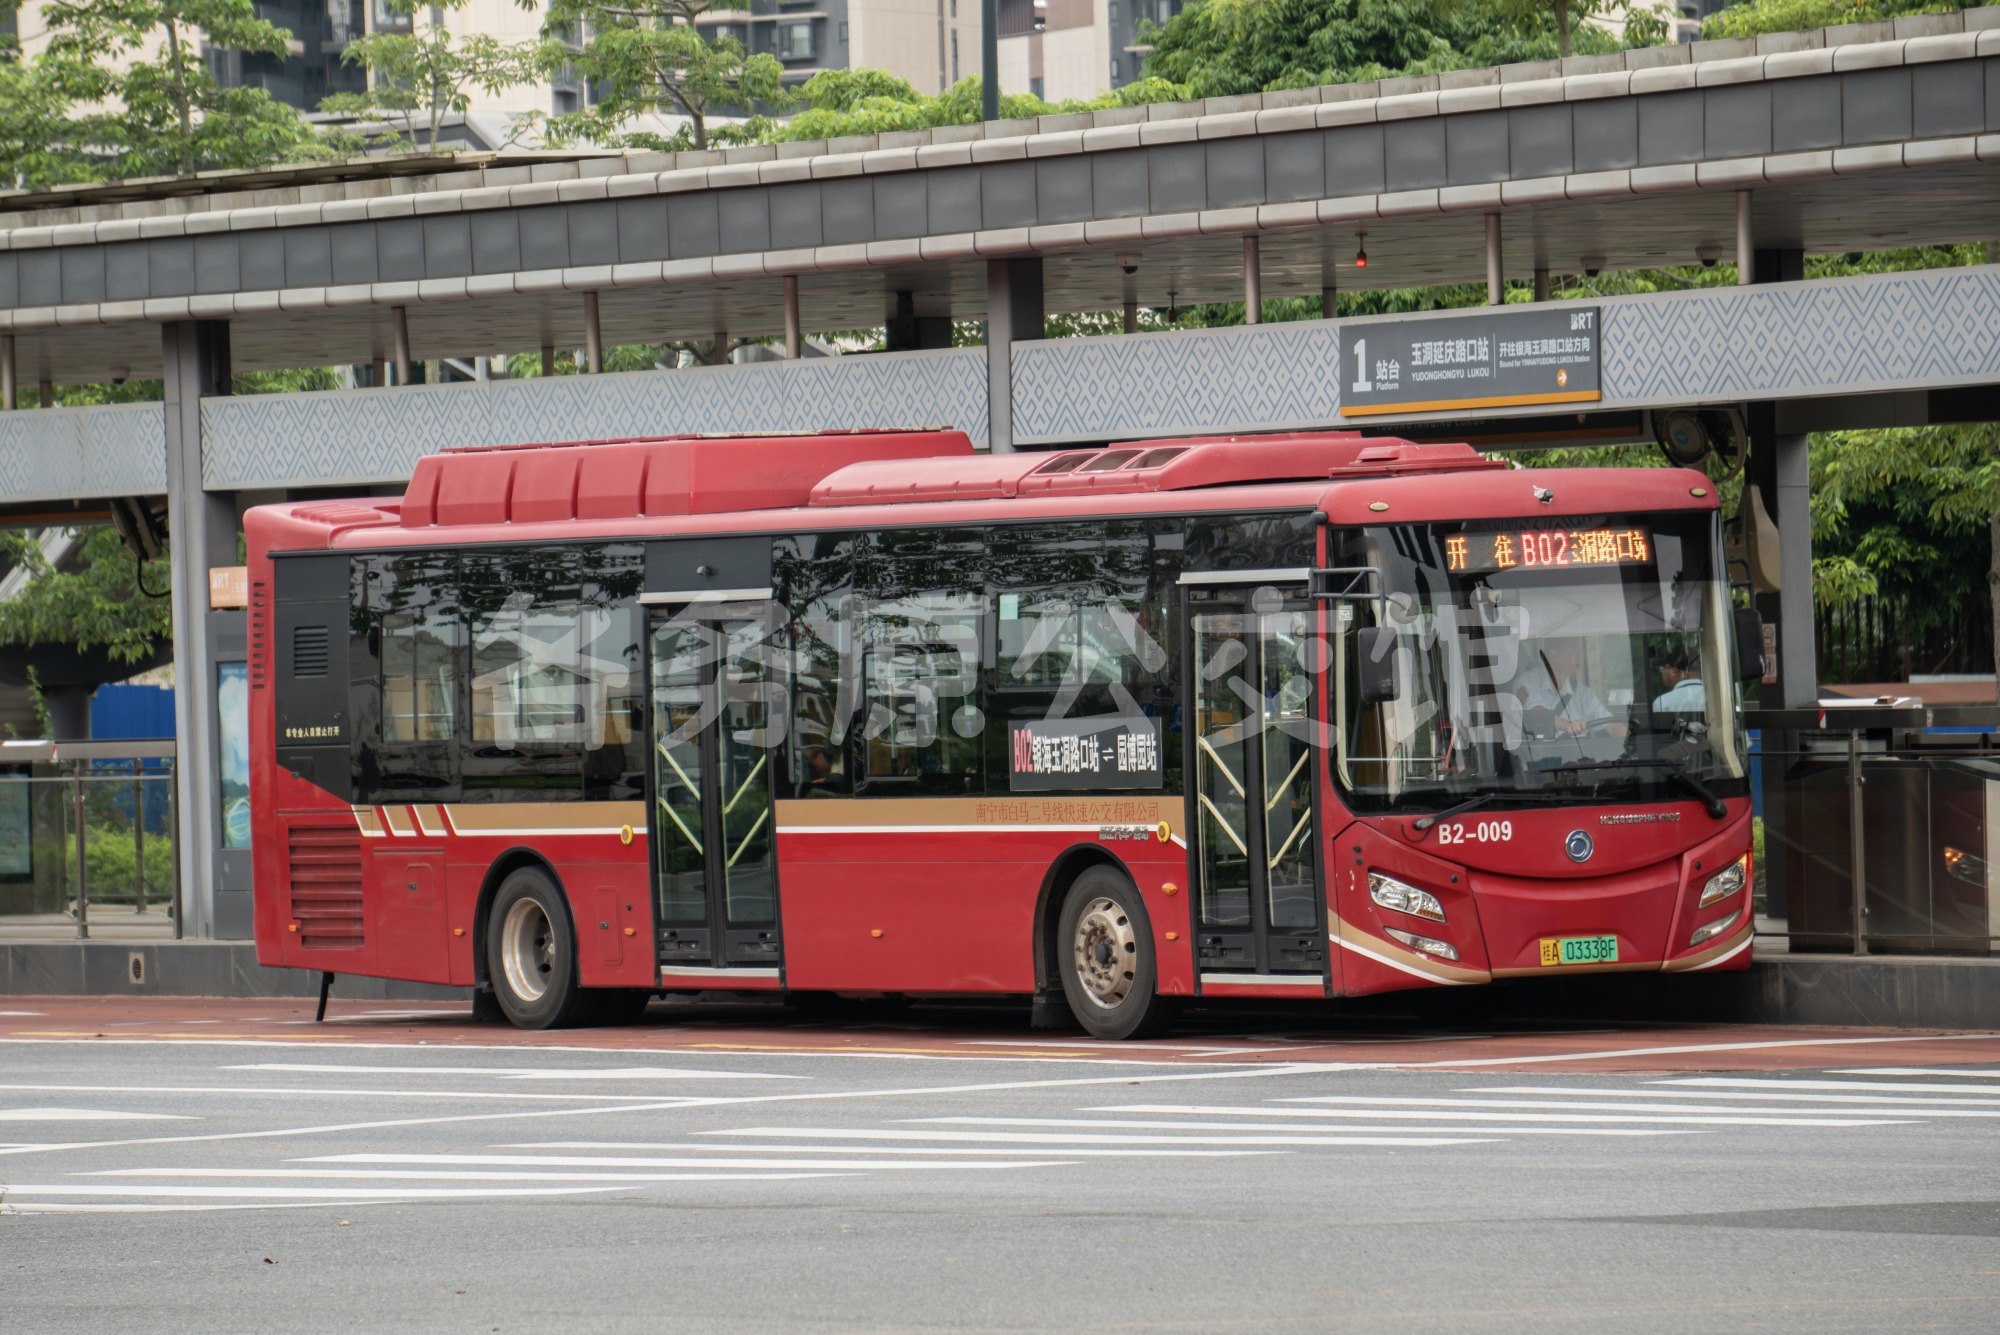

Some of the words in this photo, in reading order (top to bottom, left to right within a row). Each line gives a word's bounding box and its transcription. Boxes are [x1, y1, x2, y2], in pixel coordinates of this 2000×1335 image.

[1411, 337, 1489, 366] 玉洞延庆路口站
[1499, 336, 1590, 358] 开往银海玉洞路口站方向
[1352, 338, 1372, 393] 1
[1376, 359, 1400, 381] 站台
[1467, 367, 1489, 378] LUKOU
[1499, 360, 1514, 368] Bound
[1557, 355, 1574, 364] LUKOU
[1574, 355, 1590, 363] Station
[1376, 381, 1399, 391] Platform
[975, 801, 1159, 822] 南宁市白马二号线快速公交有限公司
[1439, 821, 1512, 844] B2-009
